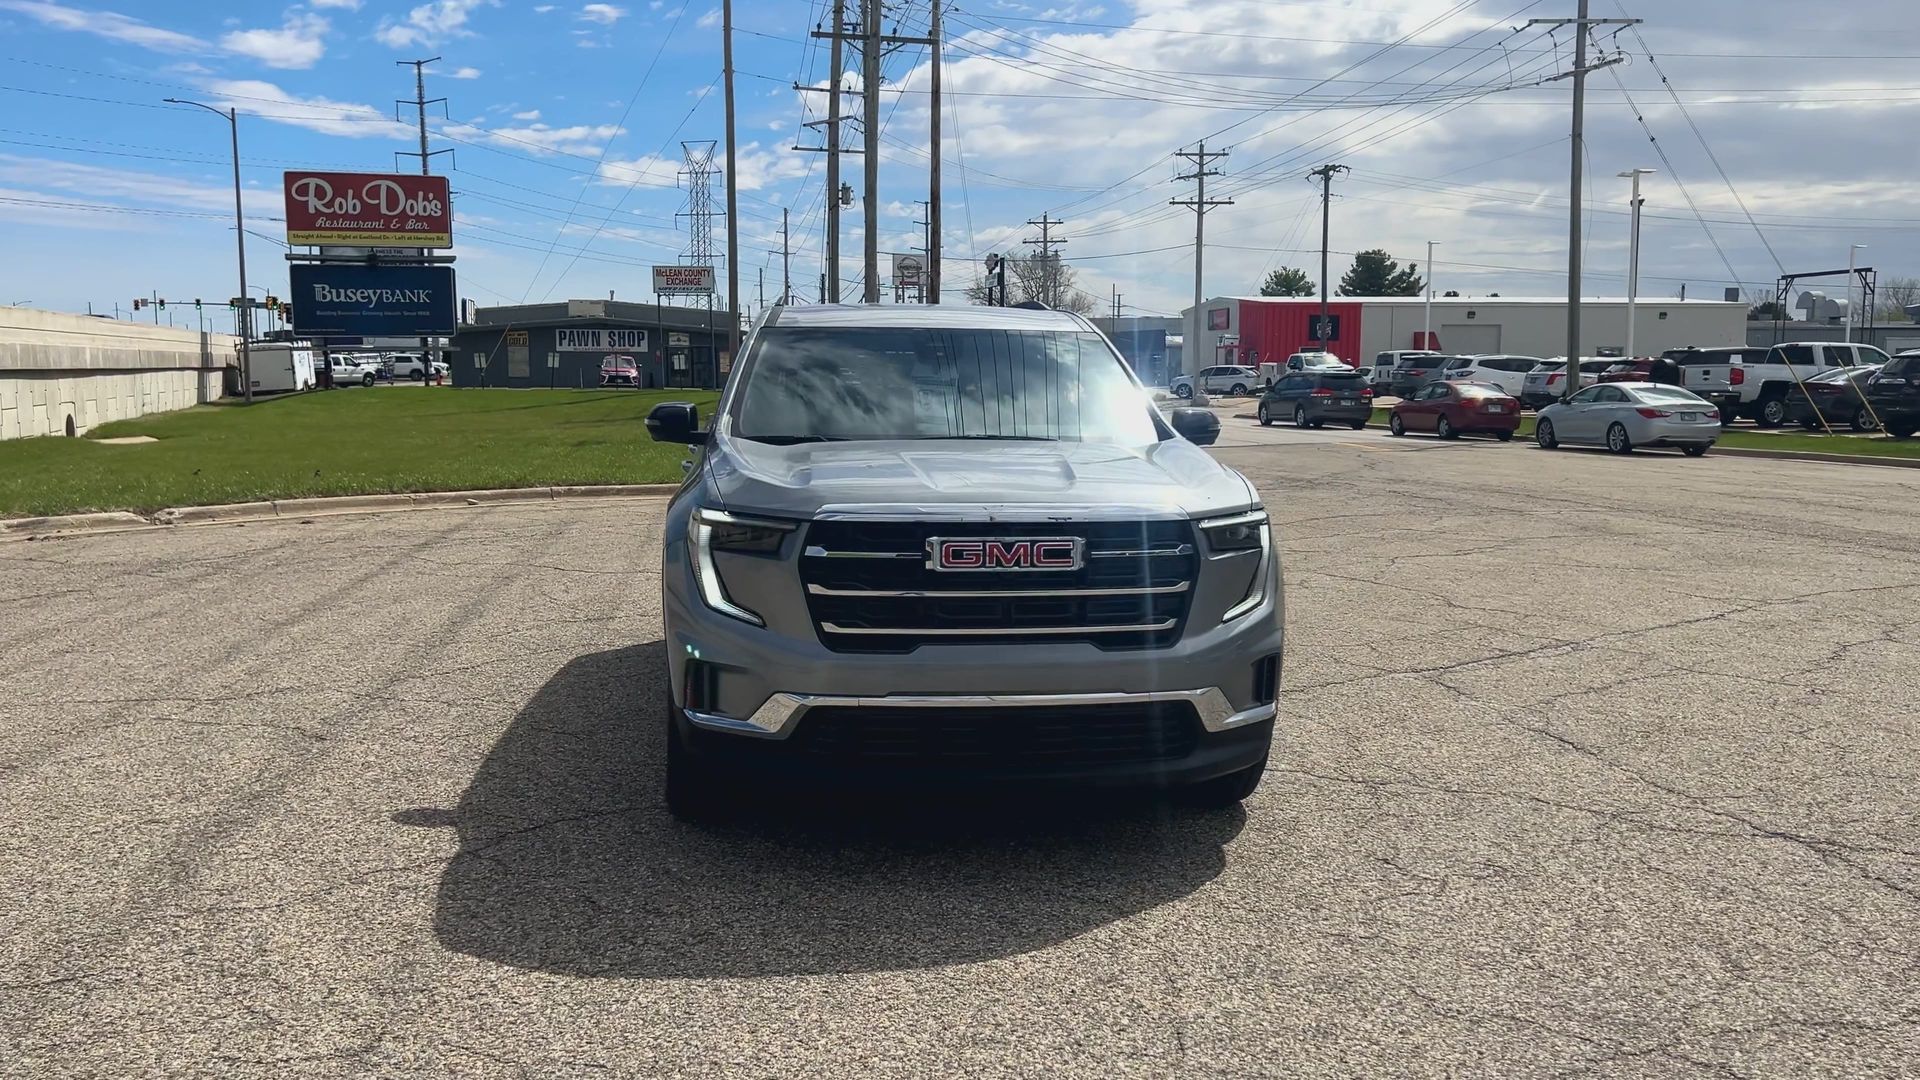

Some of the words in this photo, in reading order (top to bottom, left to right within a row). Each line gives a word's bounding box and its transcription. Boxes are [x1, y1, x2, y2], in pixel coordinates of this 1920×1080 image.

[291, 177, 361, 215] Rob
[362, 179, 442, 217] Dob's
[315, 216, 385, 230] Restaurant
[390, 218, 401, 230] &
[405, 218, 430, 231] Bar
[656, 268, 683, 277] McLEAN
[683, 269, 711, 277] COUNTY
[666, 277, 702, 286] EXCHANGE
[558, 330, 601, 347] PAWN
[942, 541, 1073, 567] GMC
